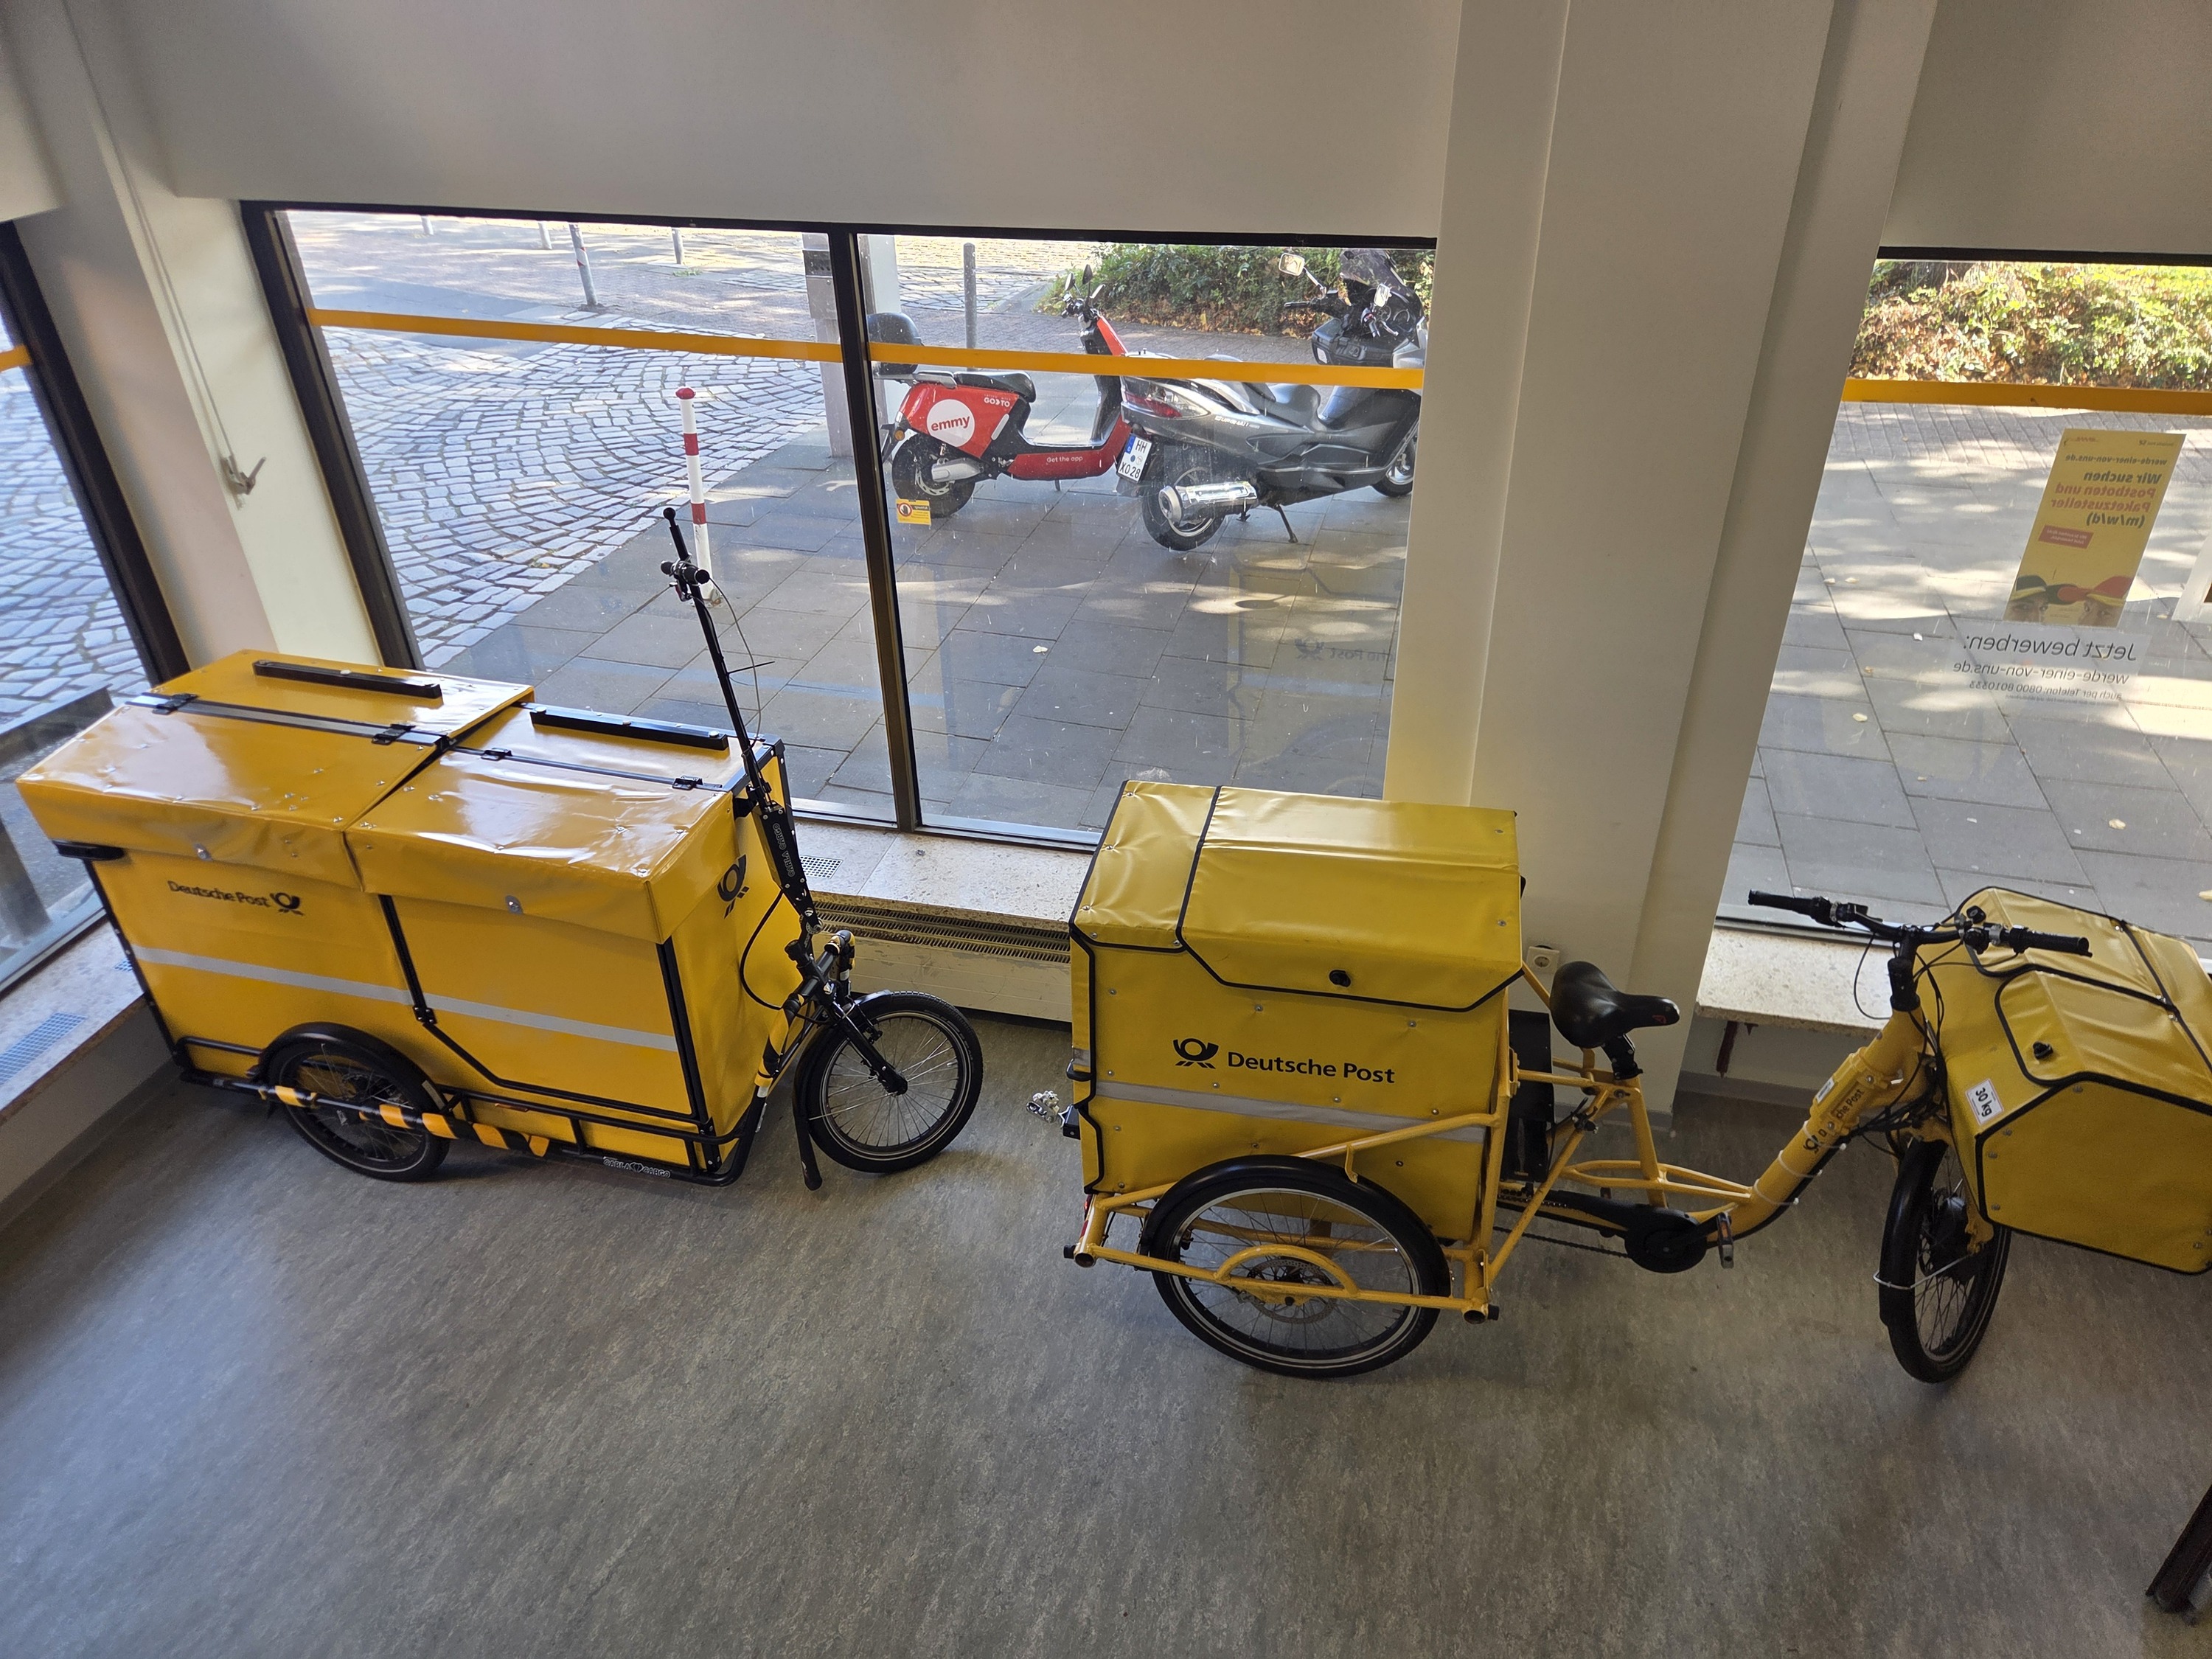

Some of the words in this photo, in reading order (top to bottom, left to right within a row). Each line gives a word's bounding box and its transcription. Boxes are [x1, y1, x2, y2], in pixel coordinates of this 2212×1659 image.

[931, 416, 970, 431] emmy
[1135, 439, 1147, 453] HH
[1130, 466, 1141, 479] 28
[772, 823, 787, 850] CARGO
[782, 850, 796, 877] CARLA
[167, 880, 235, 902] Deutsche
[235, 891, 271, 908] Post
[1228, 1051, 1337, 1077] Deutsche
[1343, 1062, 1395, 1084] Post
[1846, 1088, 1865, 1106] Post
[1975, 1087, 1989, 1102] 30
[1981, 1100, 1992, 1117] kg
[603, 1158, 632, 1171] CARLA
[643, 1166, 671, 1178] CARGO
